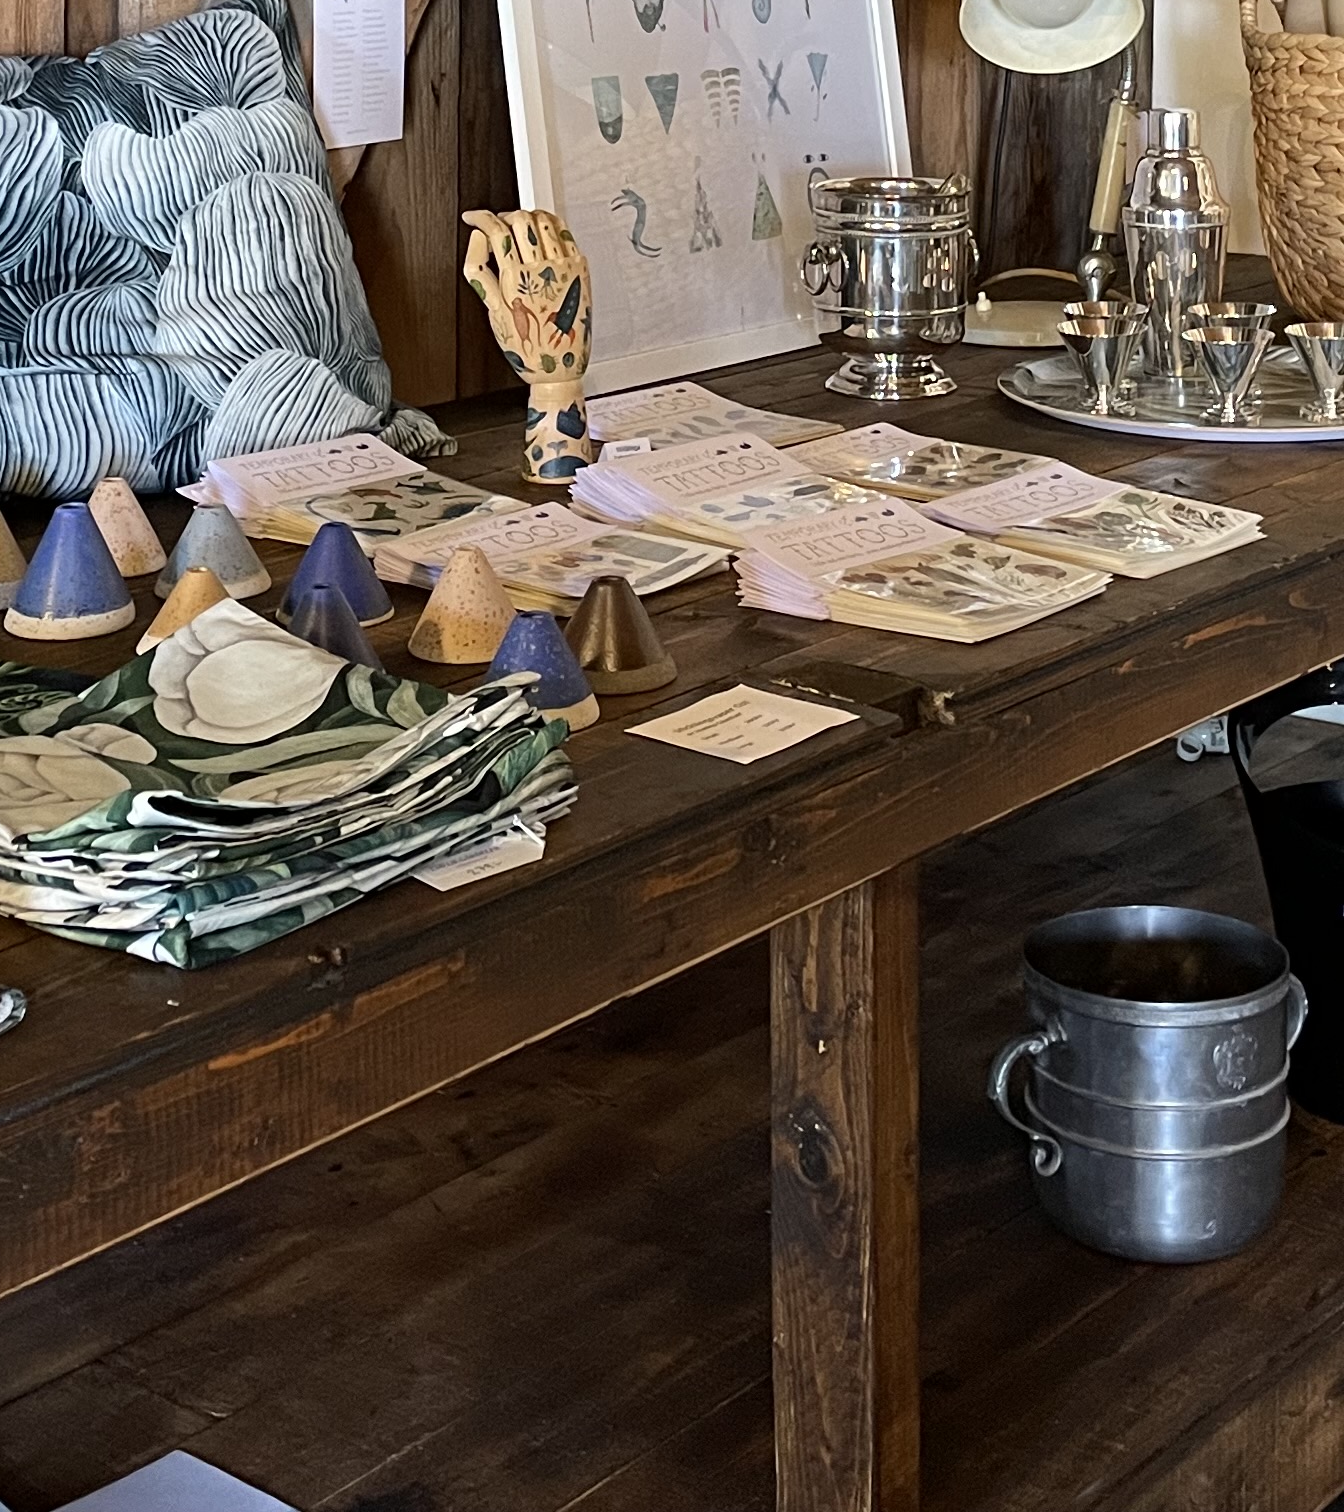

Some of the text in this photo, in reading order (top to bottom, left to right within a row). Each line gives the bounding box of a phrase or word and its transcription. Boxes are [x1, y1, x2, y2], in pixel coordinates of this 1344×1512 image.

[252, 451, 395, 488] TATTOOS
[654, 451, 781, 492] TATTOOS
[962, 480, 1094, 519] TATTOOS
[781, 519, 926, 561] TATTOOS
